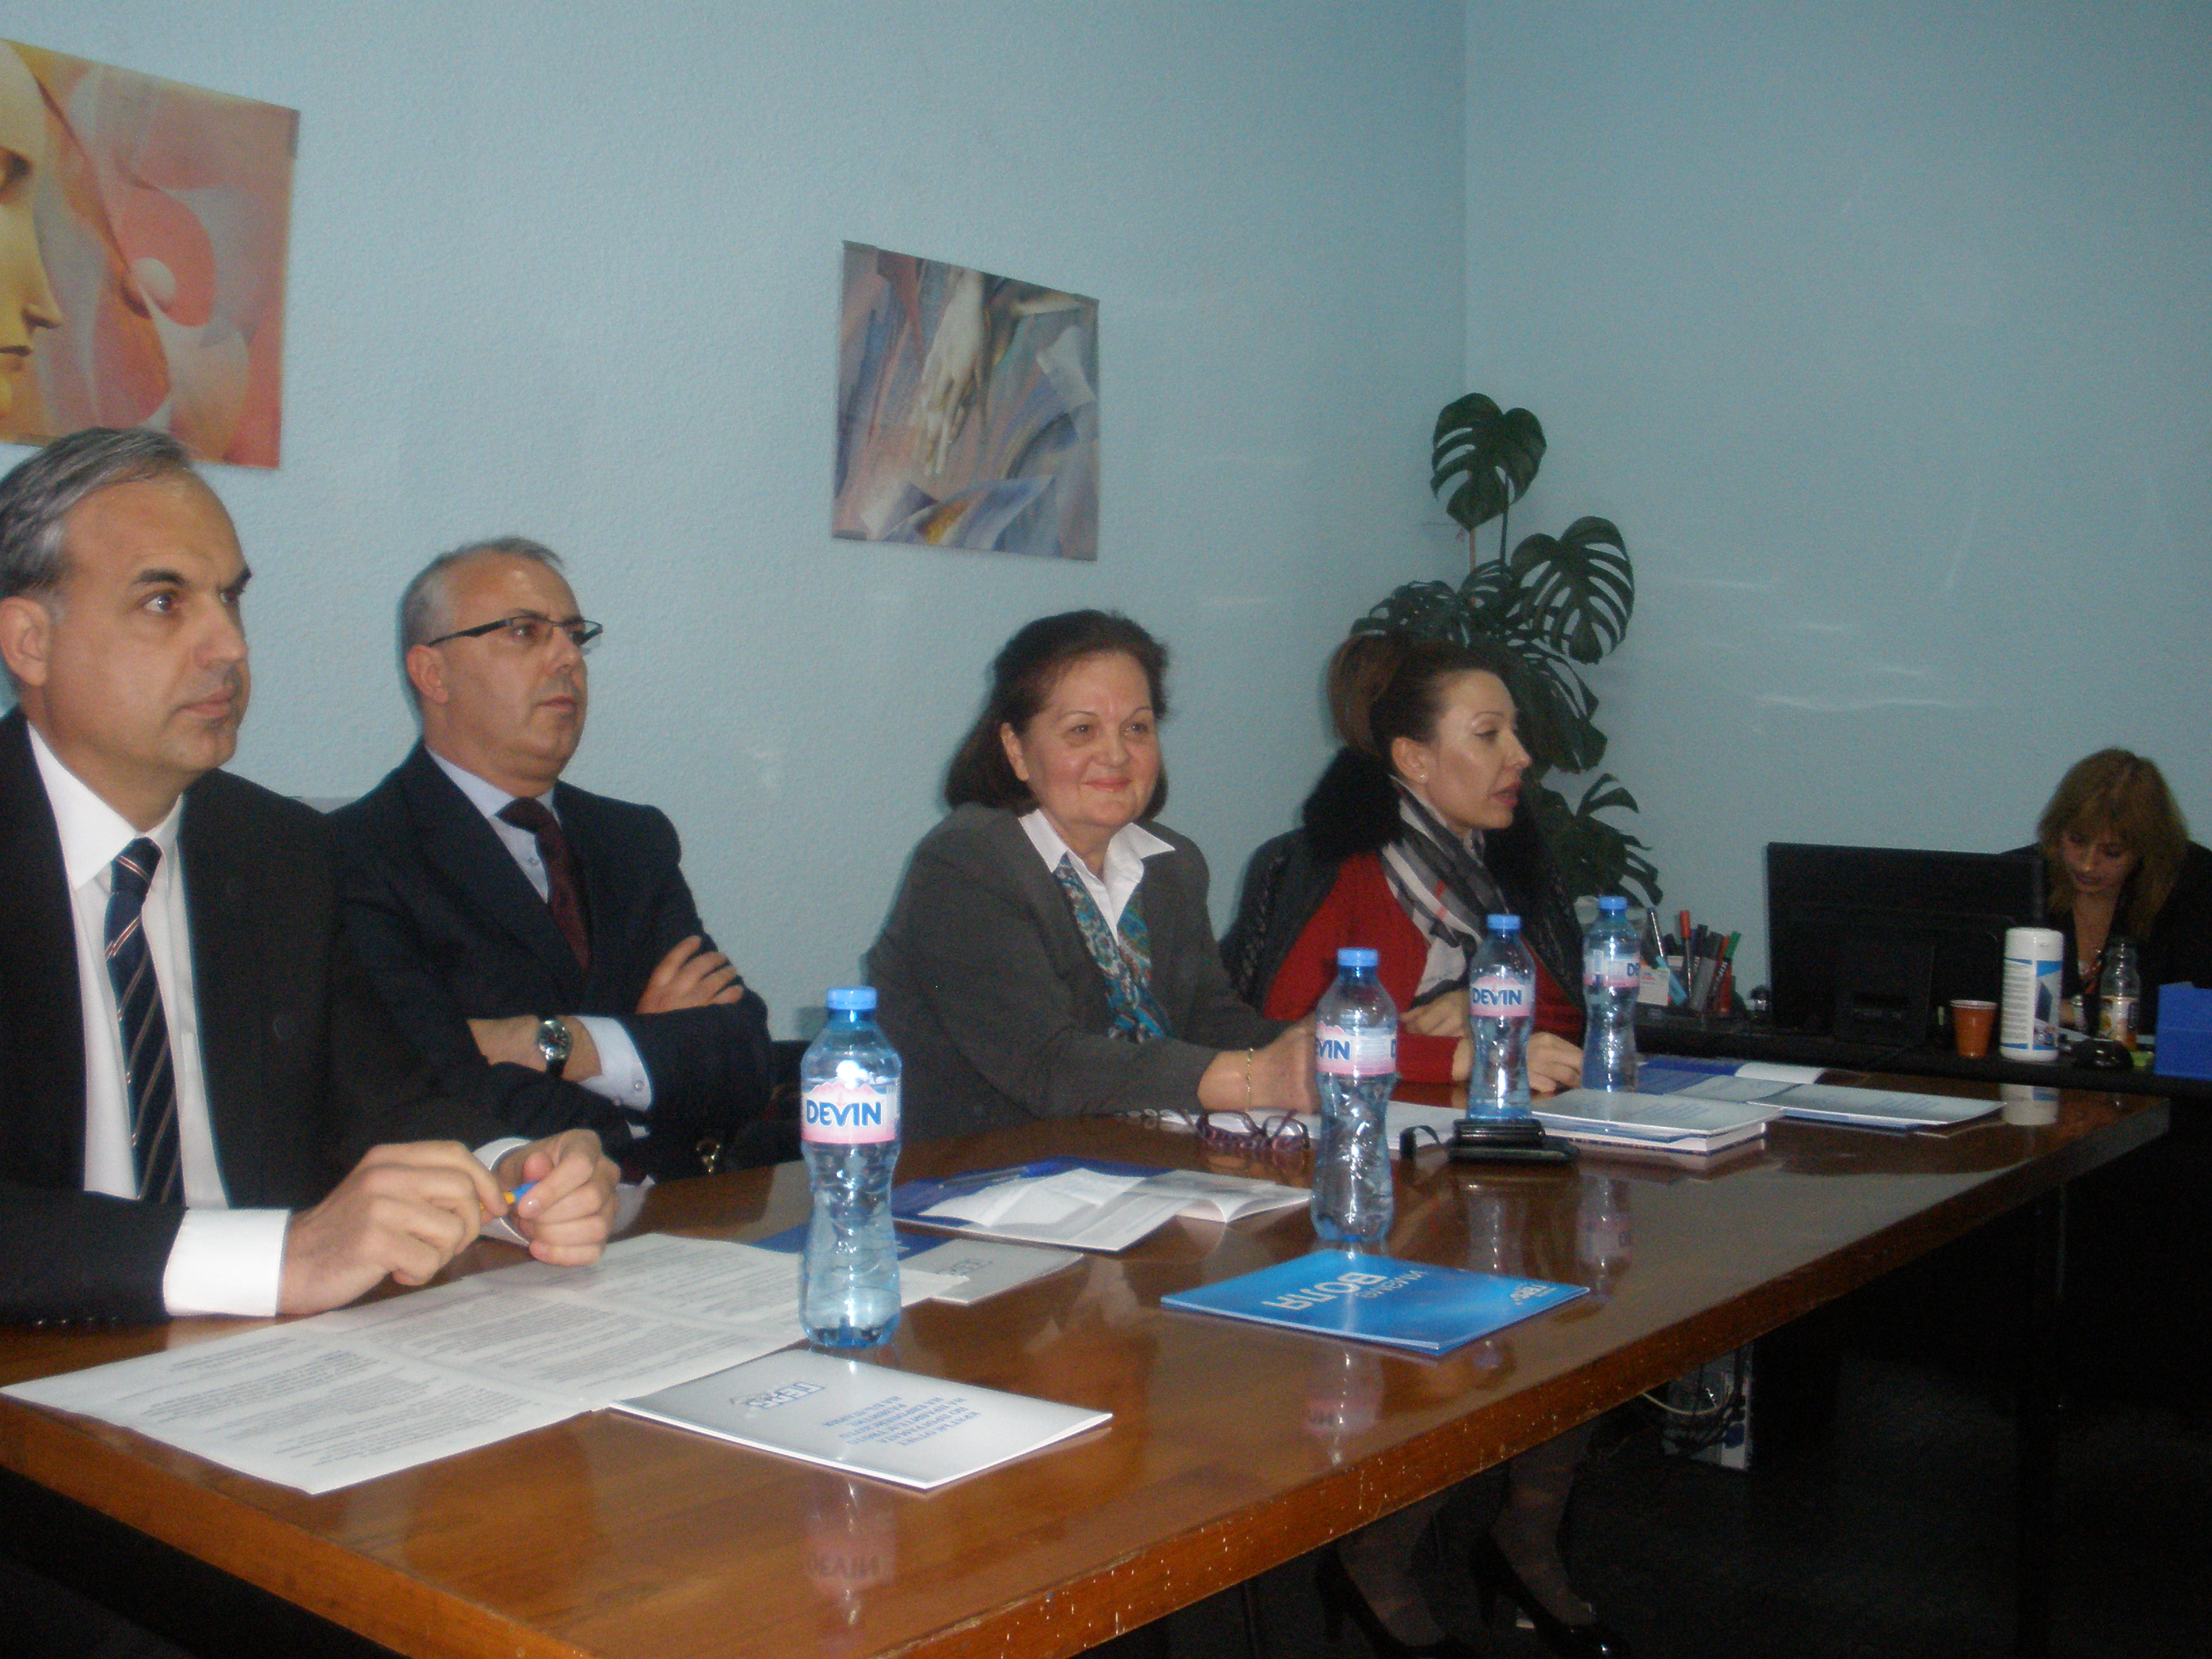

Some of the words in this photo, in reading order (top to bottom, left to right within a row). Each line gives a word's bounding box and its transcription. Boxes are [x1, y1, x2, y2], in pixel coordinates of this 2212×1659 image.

[1473, 987, 1522, 1006] DEVIN
[1317, 1038, 1351, 1061] VIN
[806, 1099, 882, 1128] DEVIN
[1261, 1271, 1388, 1311] ВОЛЯ
